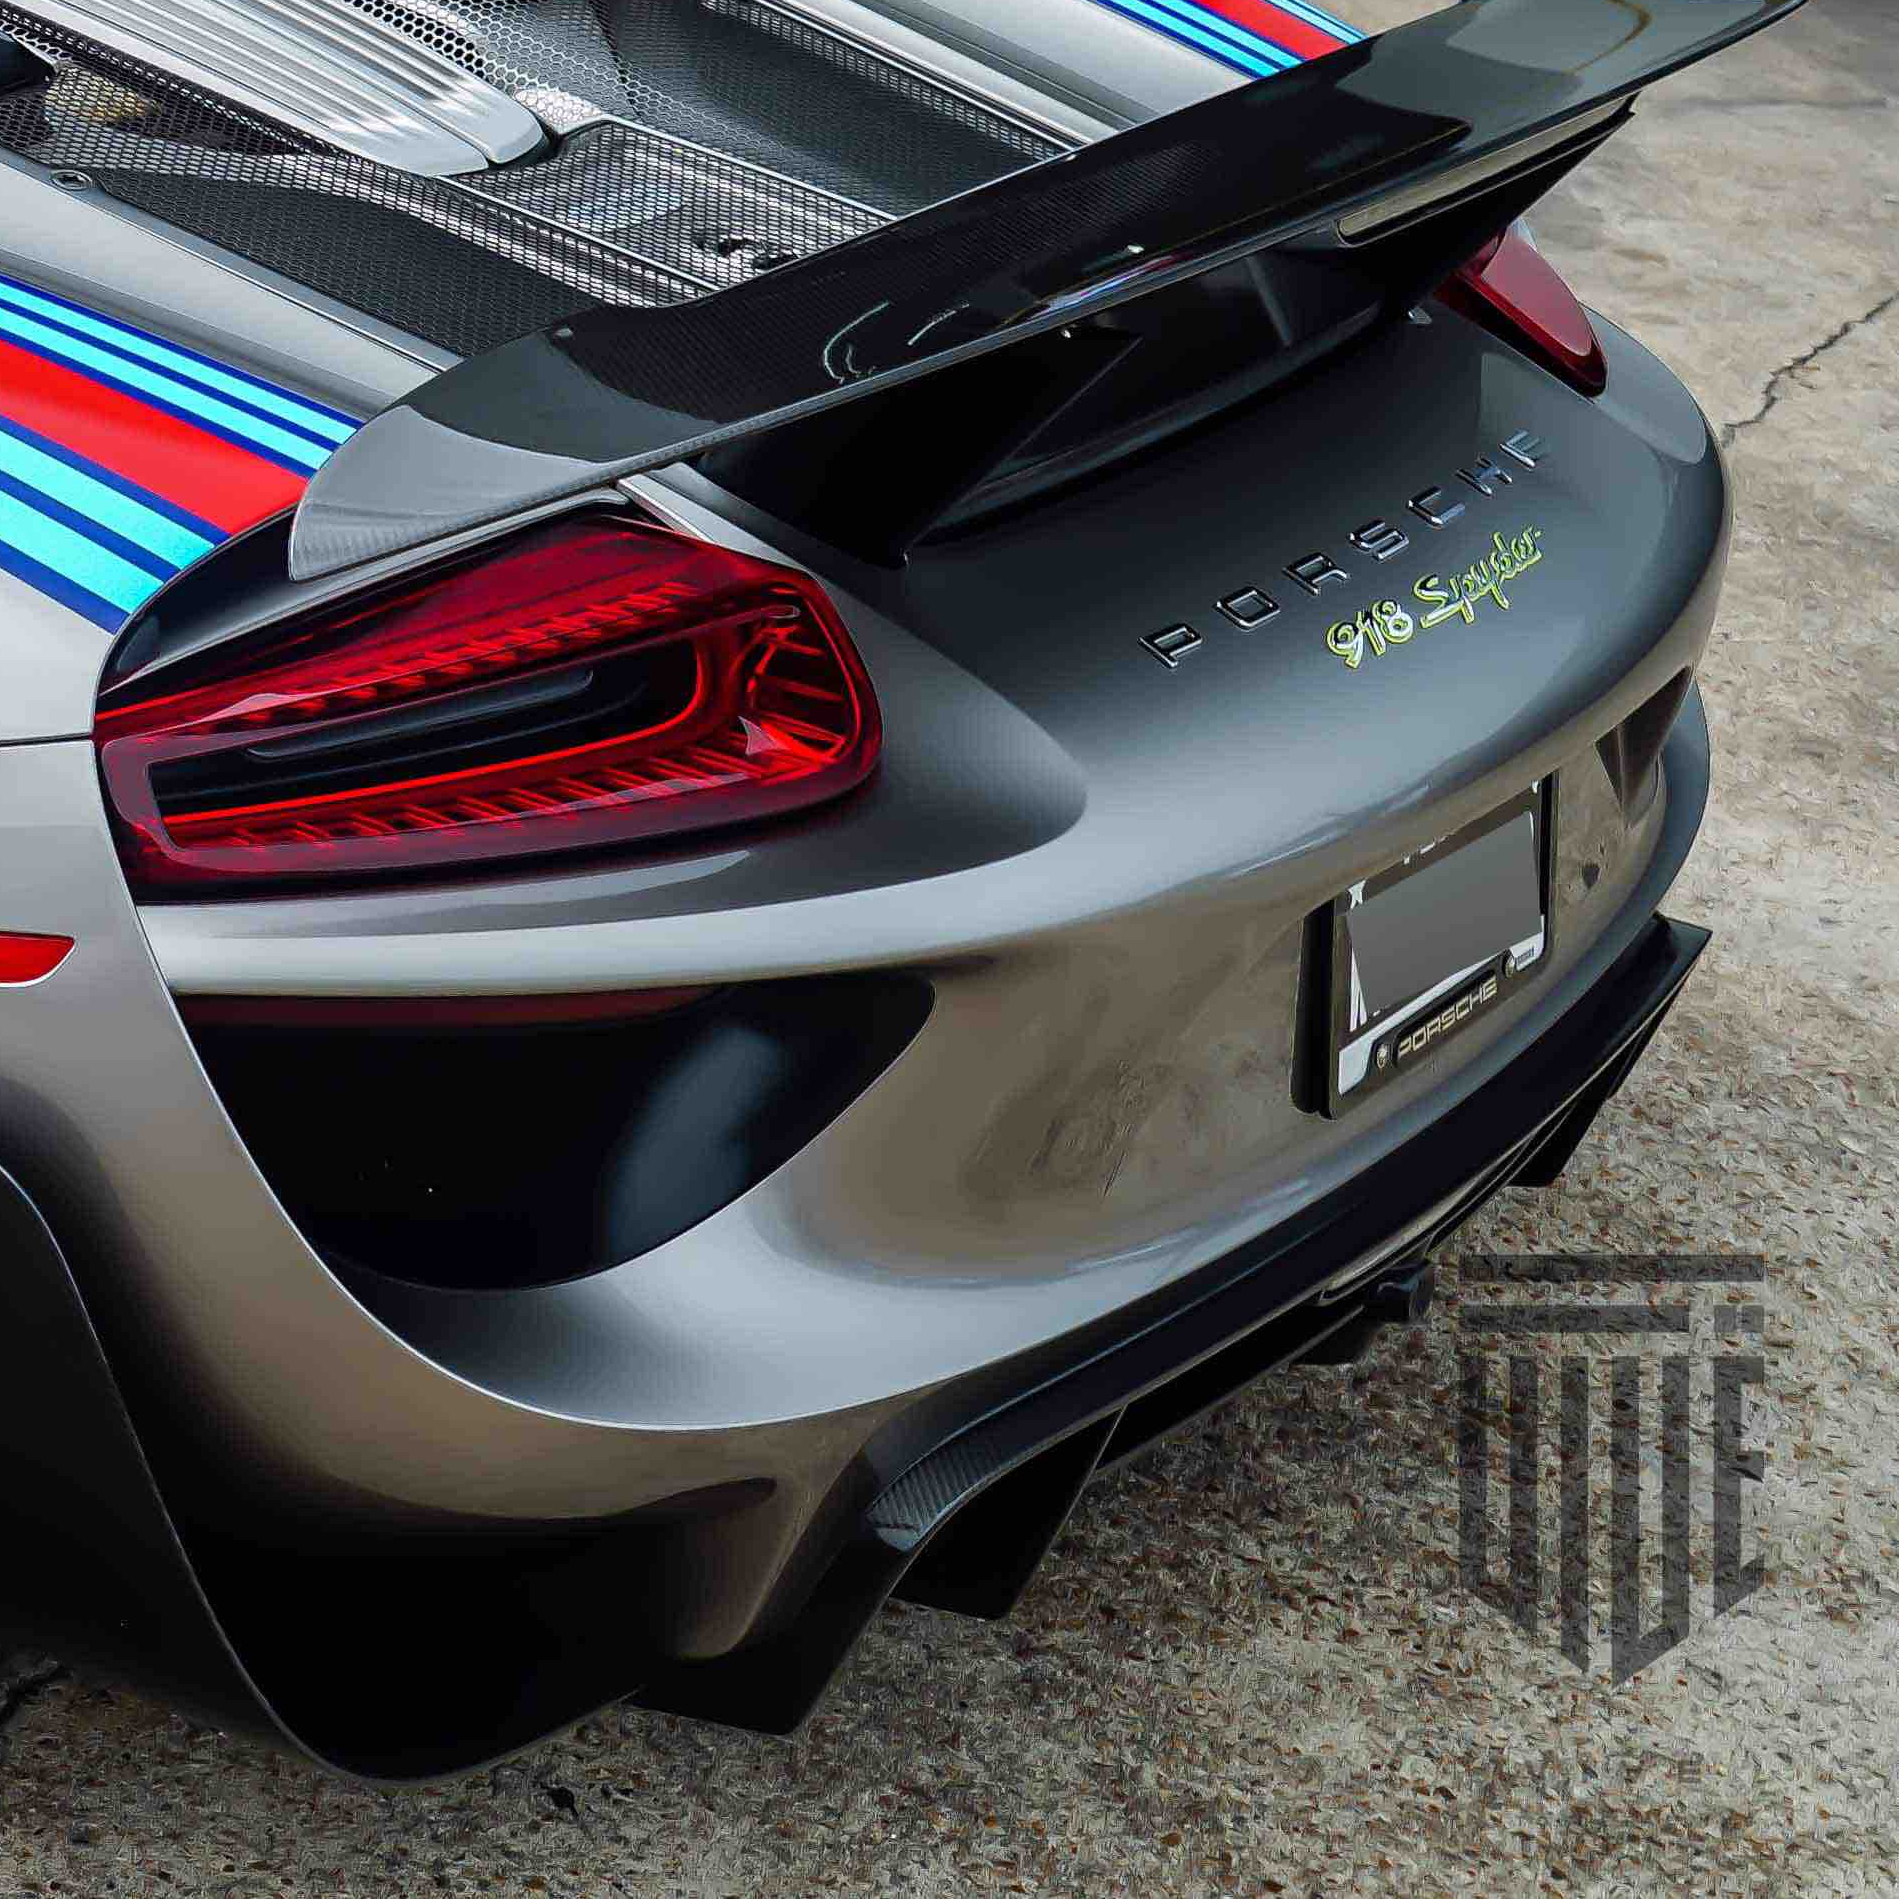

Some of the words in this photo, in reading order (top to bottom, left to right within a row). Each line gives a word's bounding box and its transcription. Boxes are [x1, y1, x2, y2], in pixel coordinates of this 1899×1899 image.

[1137, 428, 1544, 670] PORSCHE
[1325, 599, 1415, 670] 918
[1413, 524, 1544, 630] Spyder
[1397, 974, 1499, 1057] PORSCHE
